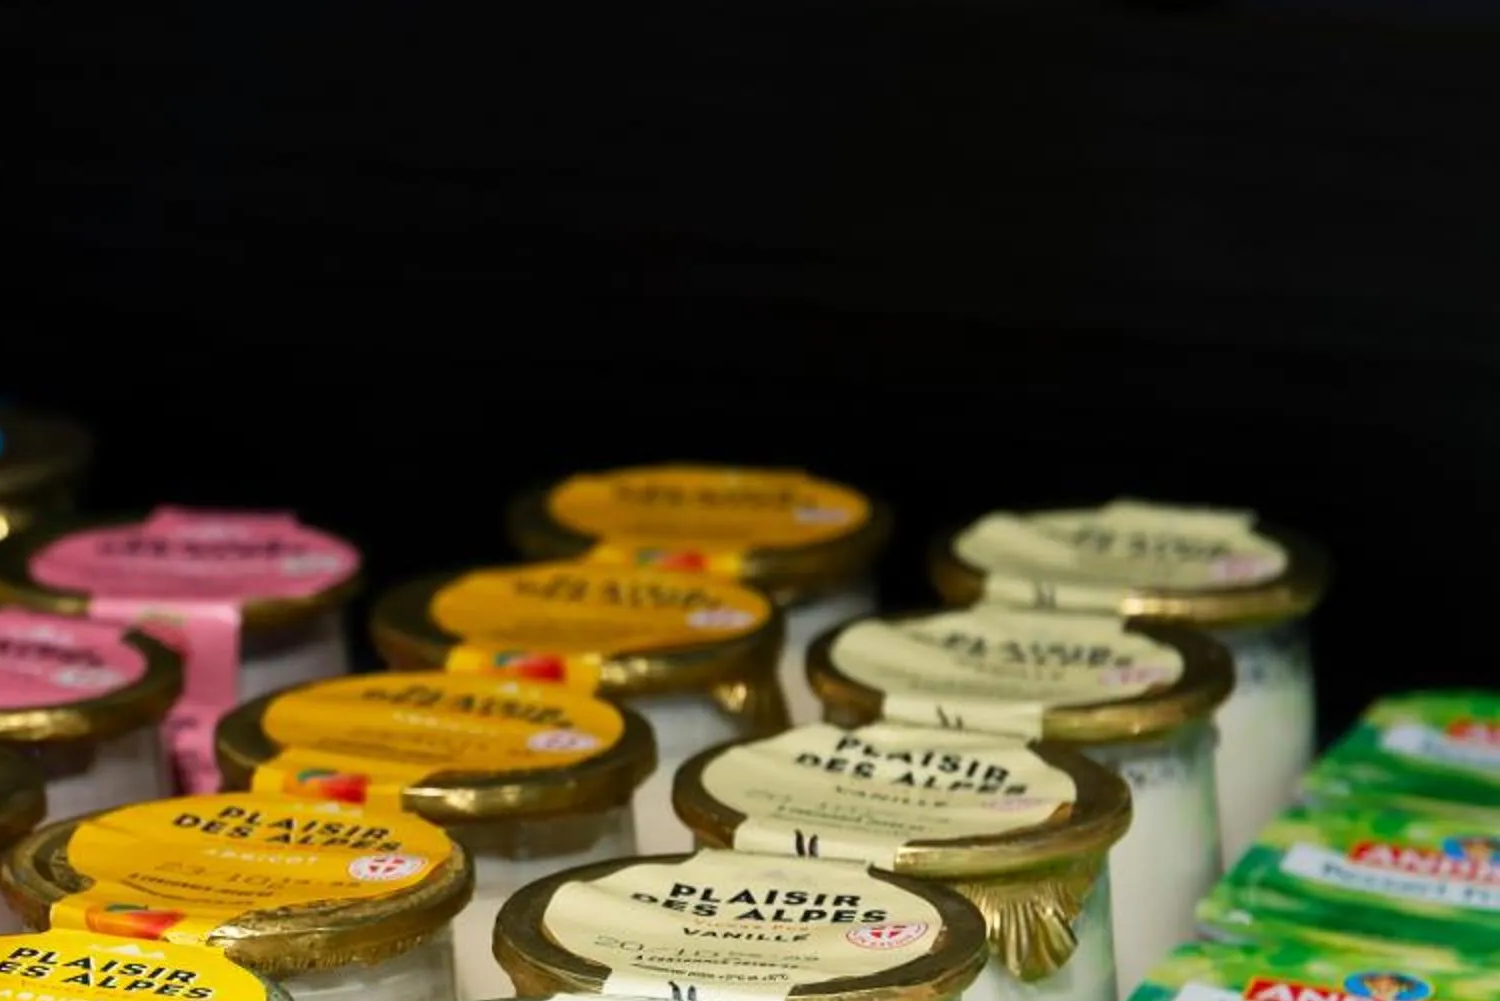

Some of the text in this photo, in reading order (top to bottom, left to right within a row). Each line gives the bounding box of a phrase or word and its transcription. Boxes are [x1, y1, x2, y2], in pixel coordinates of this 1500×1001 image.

[173, 813, 402, 852] DES ALPES
[219, 806, 390, 839] PLAISIR
[631, 892, 888, 923] DES ALPES
[669, 883, 861, 907] PLAISIR
[683, 927, 811, 942] VANILLE
[8, 947, 198, 982] PLAISIR
[61, 972, 214, 999] ALPES
